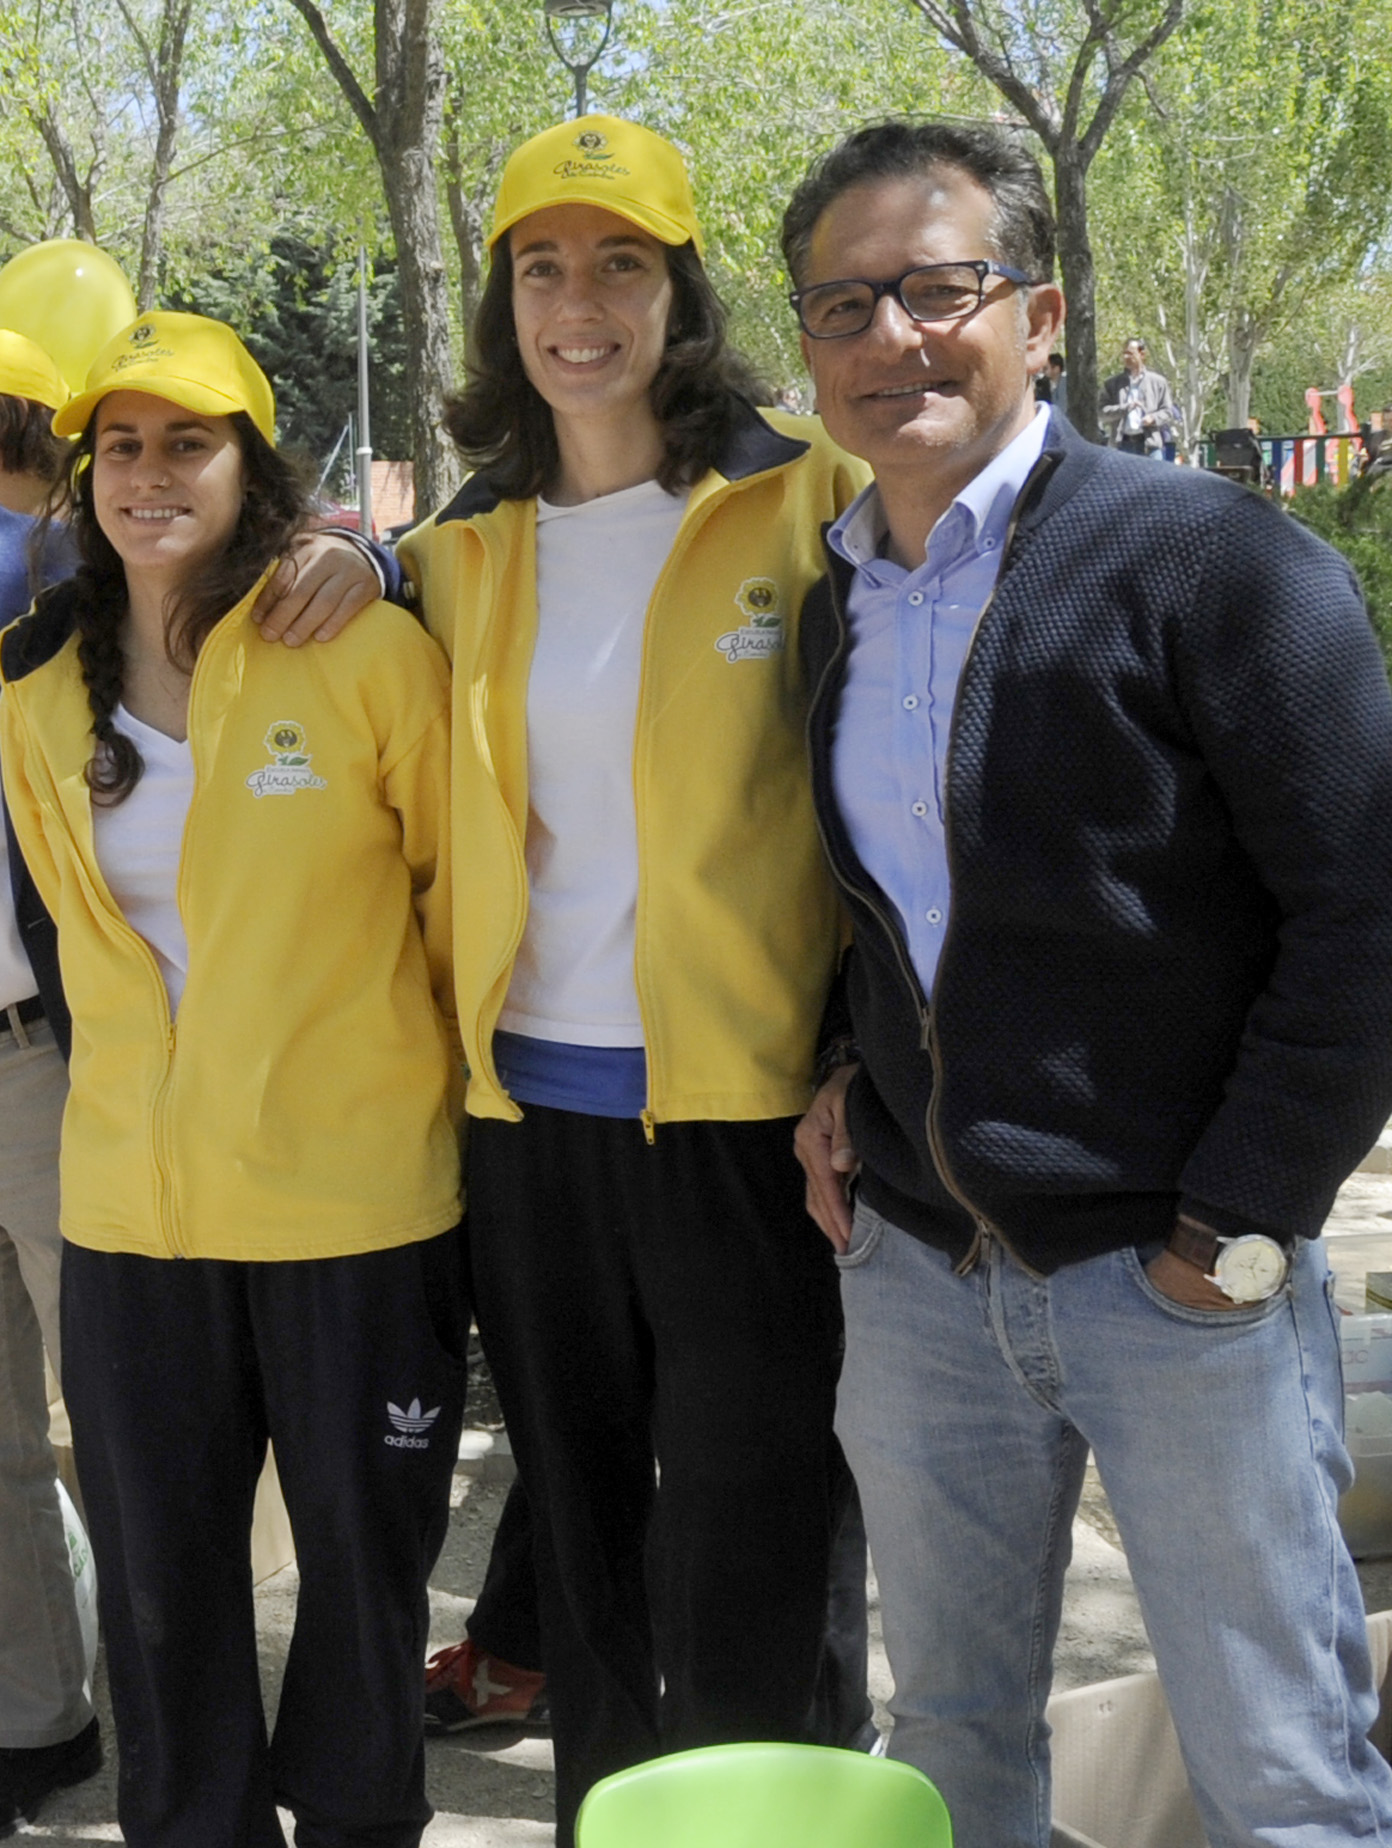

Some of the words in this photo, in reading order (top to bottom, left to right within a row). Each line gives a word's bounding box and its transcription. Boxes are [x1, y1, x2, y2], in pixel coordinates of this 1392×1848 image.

[552, 160, 631, 179] Girasoles
[245, 771, 326, 797] Girasoles
[384, 1435, 429, 1449] adidas
